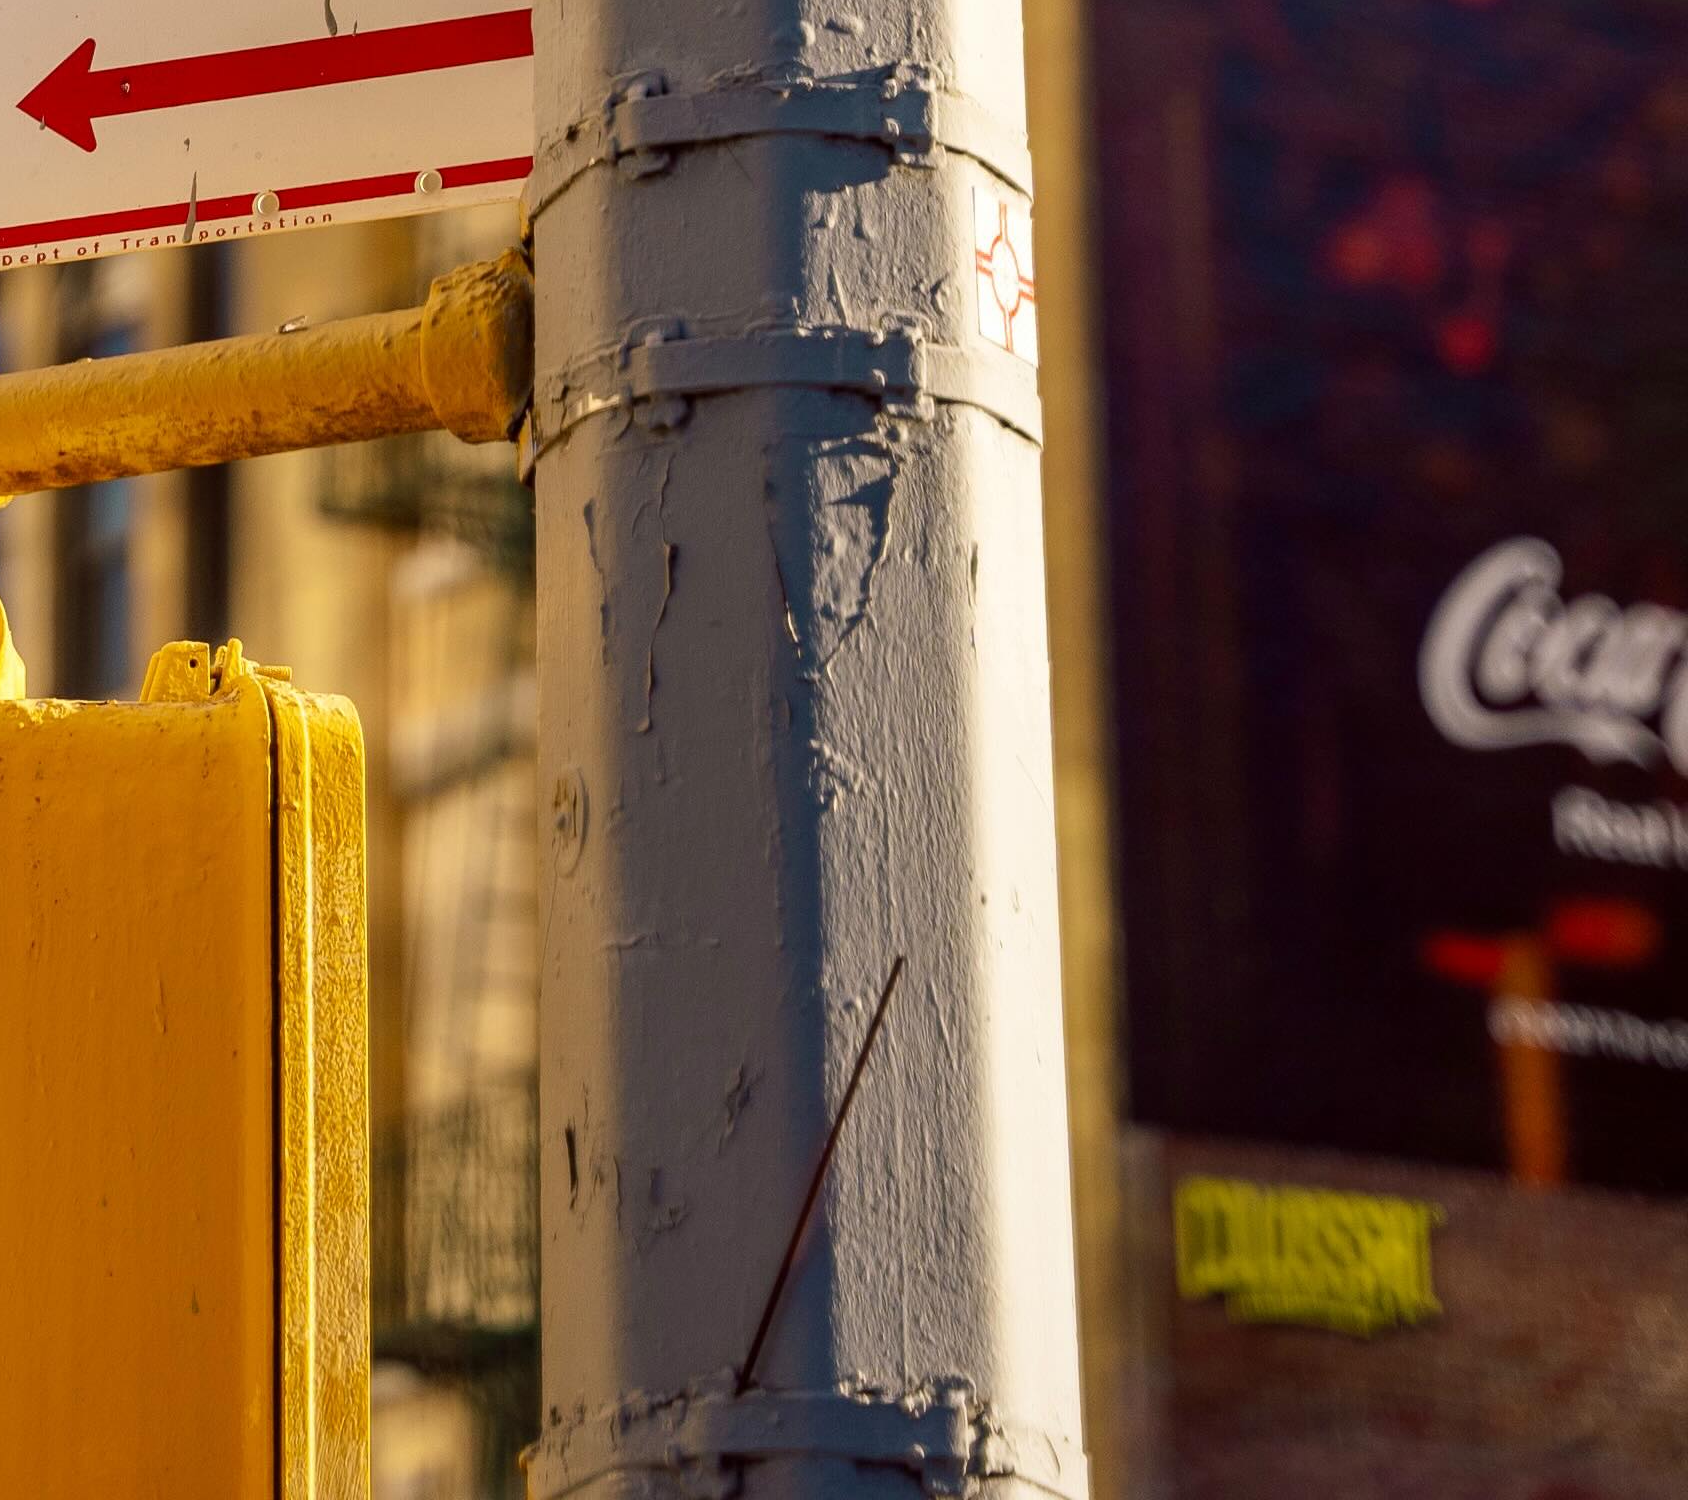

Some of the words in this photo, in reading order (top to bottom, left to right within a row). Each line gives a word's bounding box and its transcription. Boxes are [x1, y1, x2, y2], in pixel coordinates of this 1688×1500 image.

[1, 247, 60, 267] Dept
[77, 241, 101, 257] of
[120, 211, 333, 250] Tranportation
